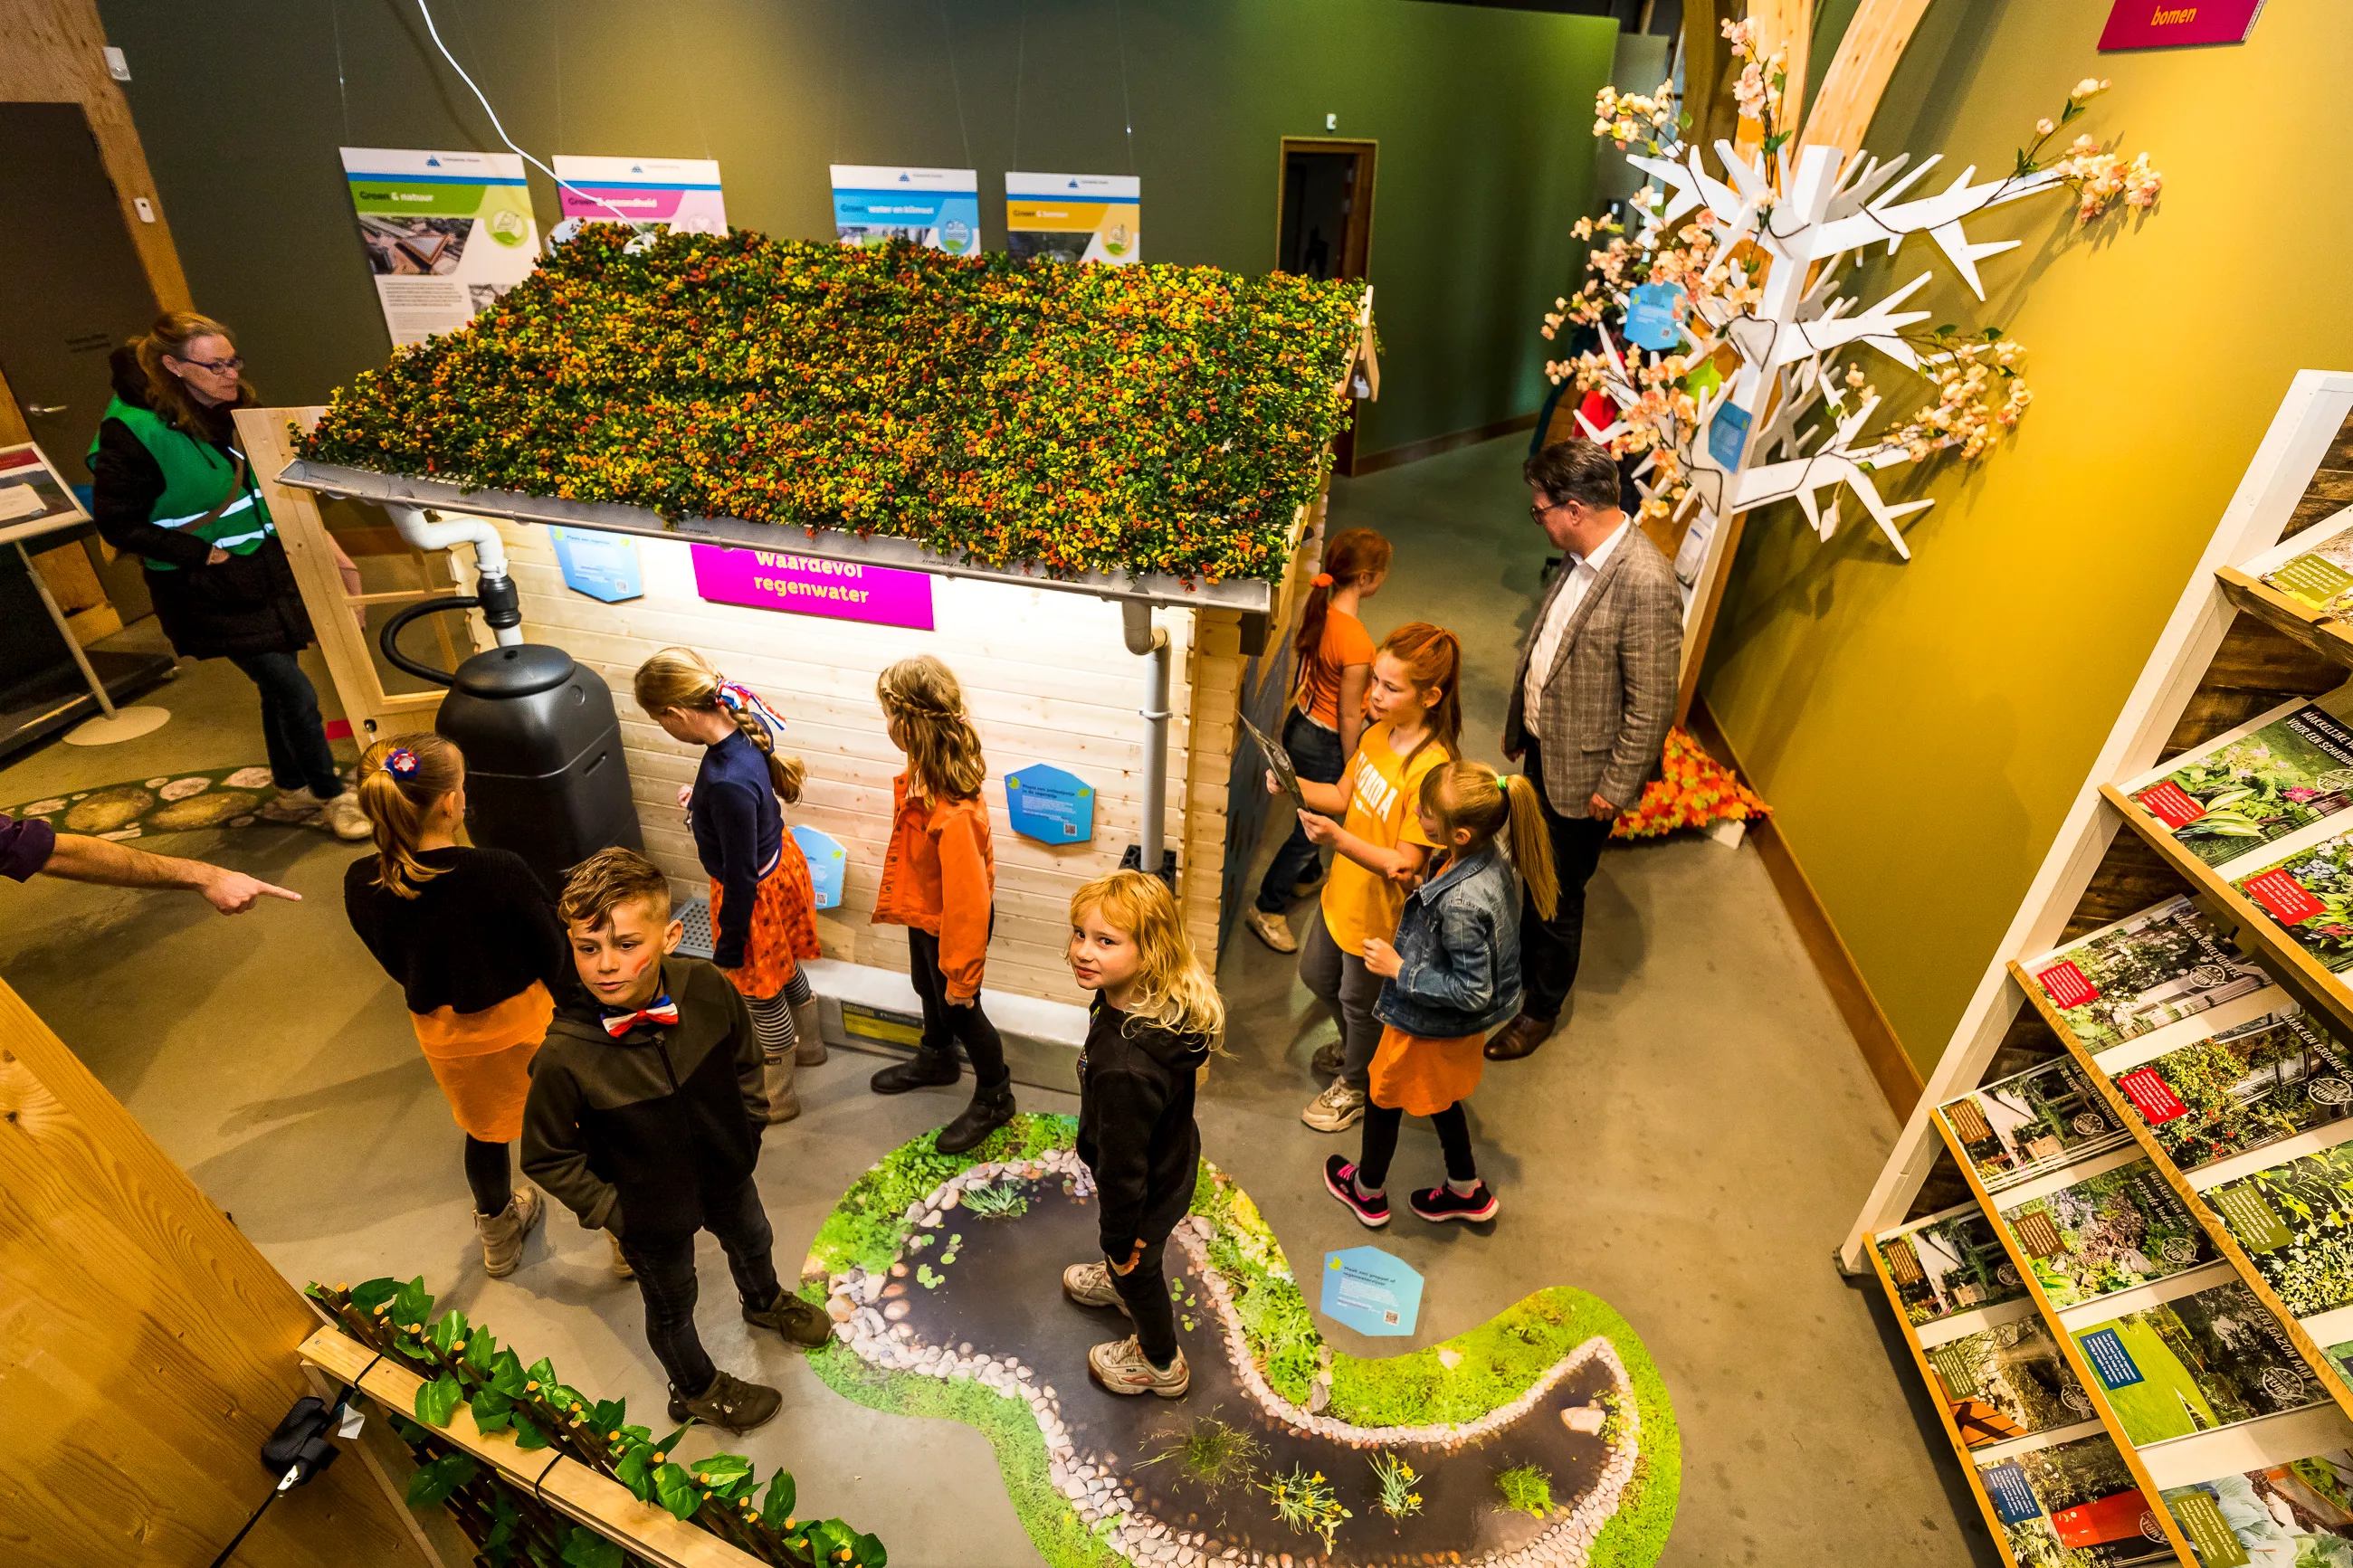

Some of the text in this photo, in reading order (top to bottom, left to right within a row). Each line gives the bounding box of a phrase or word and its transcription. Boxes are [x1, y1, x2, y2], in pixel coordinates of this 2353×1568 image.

[2150, 5, 2197, 25] bomen
[754, 576, 869, 603] regenwater
[2287, 717, 2310, 735] VOOR
[2305, 732, 2324, 745] EEN
[2301, 711, 2350, 744] MAKKELIJKE
[2173, 913, 2243, 978] MAAK EEN GEVELTUINTJE
[2282, 1014, 2305, 1032] MAAK
[2300, 1031, 2319, 1044] EEN
[2313, 1044, 2346, 1070] GROENE
[2312, 1086, 2335, 1102] TUIN
[2131, 1177, 2176, 1231] gezonde bodem
[2148, 1171, 2193, 1228] Werken aan een
[2164, 1244, 2183, 1260] TUIN
[2254, 1308, 2273, 1326] EEN
[2269, 1327, 2299, 1359] GAZON
[2291, 1360, 2315, 1379] AAN
[2266, 1375, 2289, 1396] TUIN
[2143, 1519, 2160, 1538] TUIN
